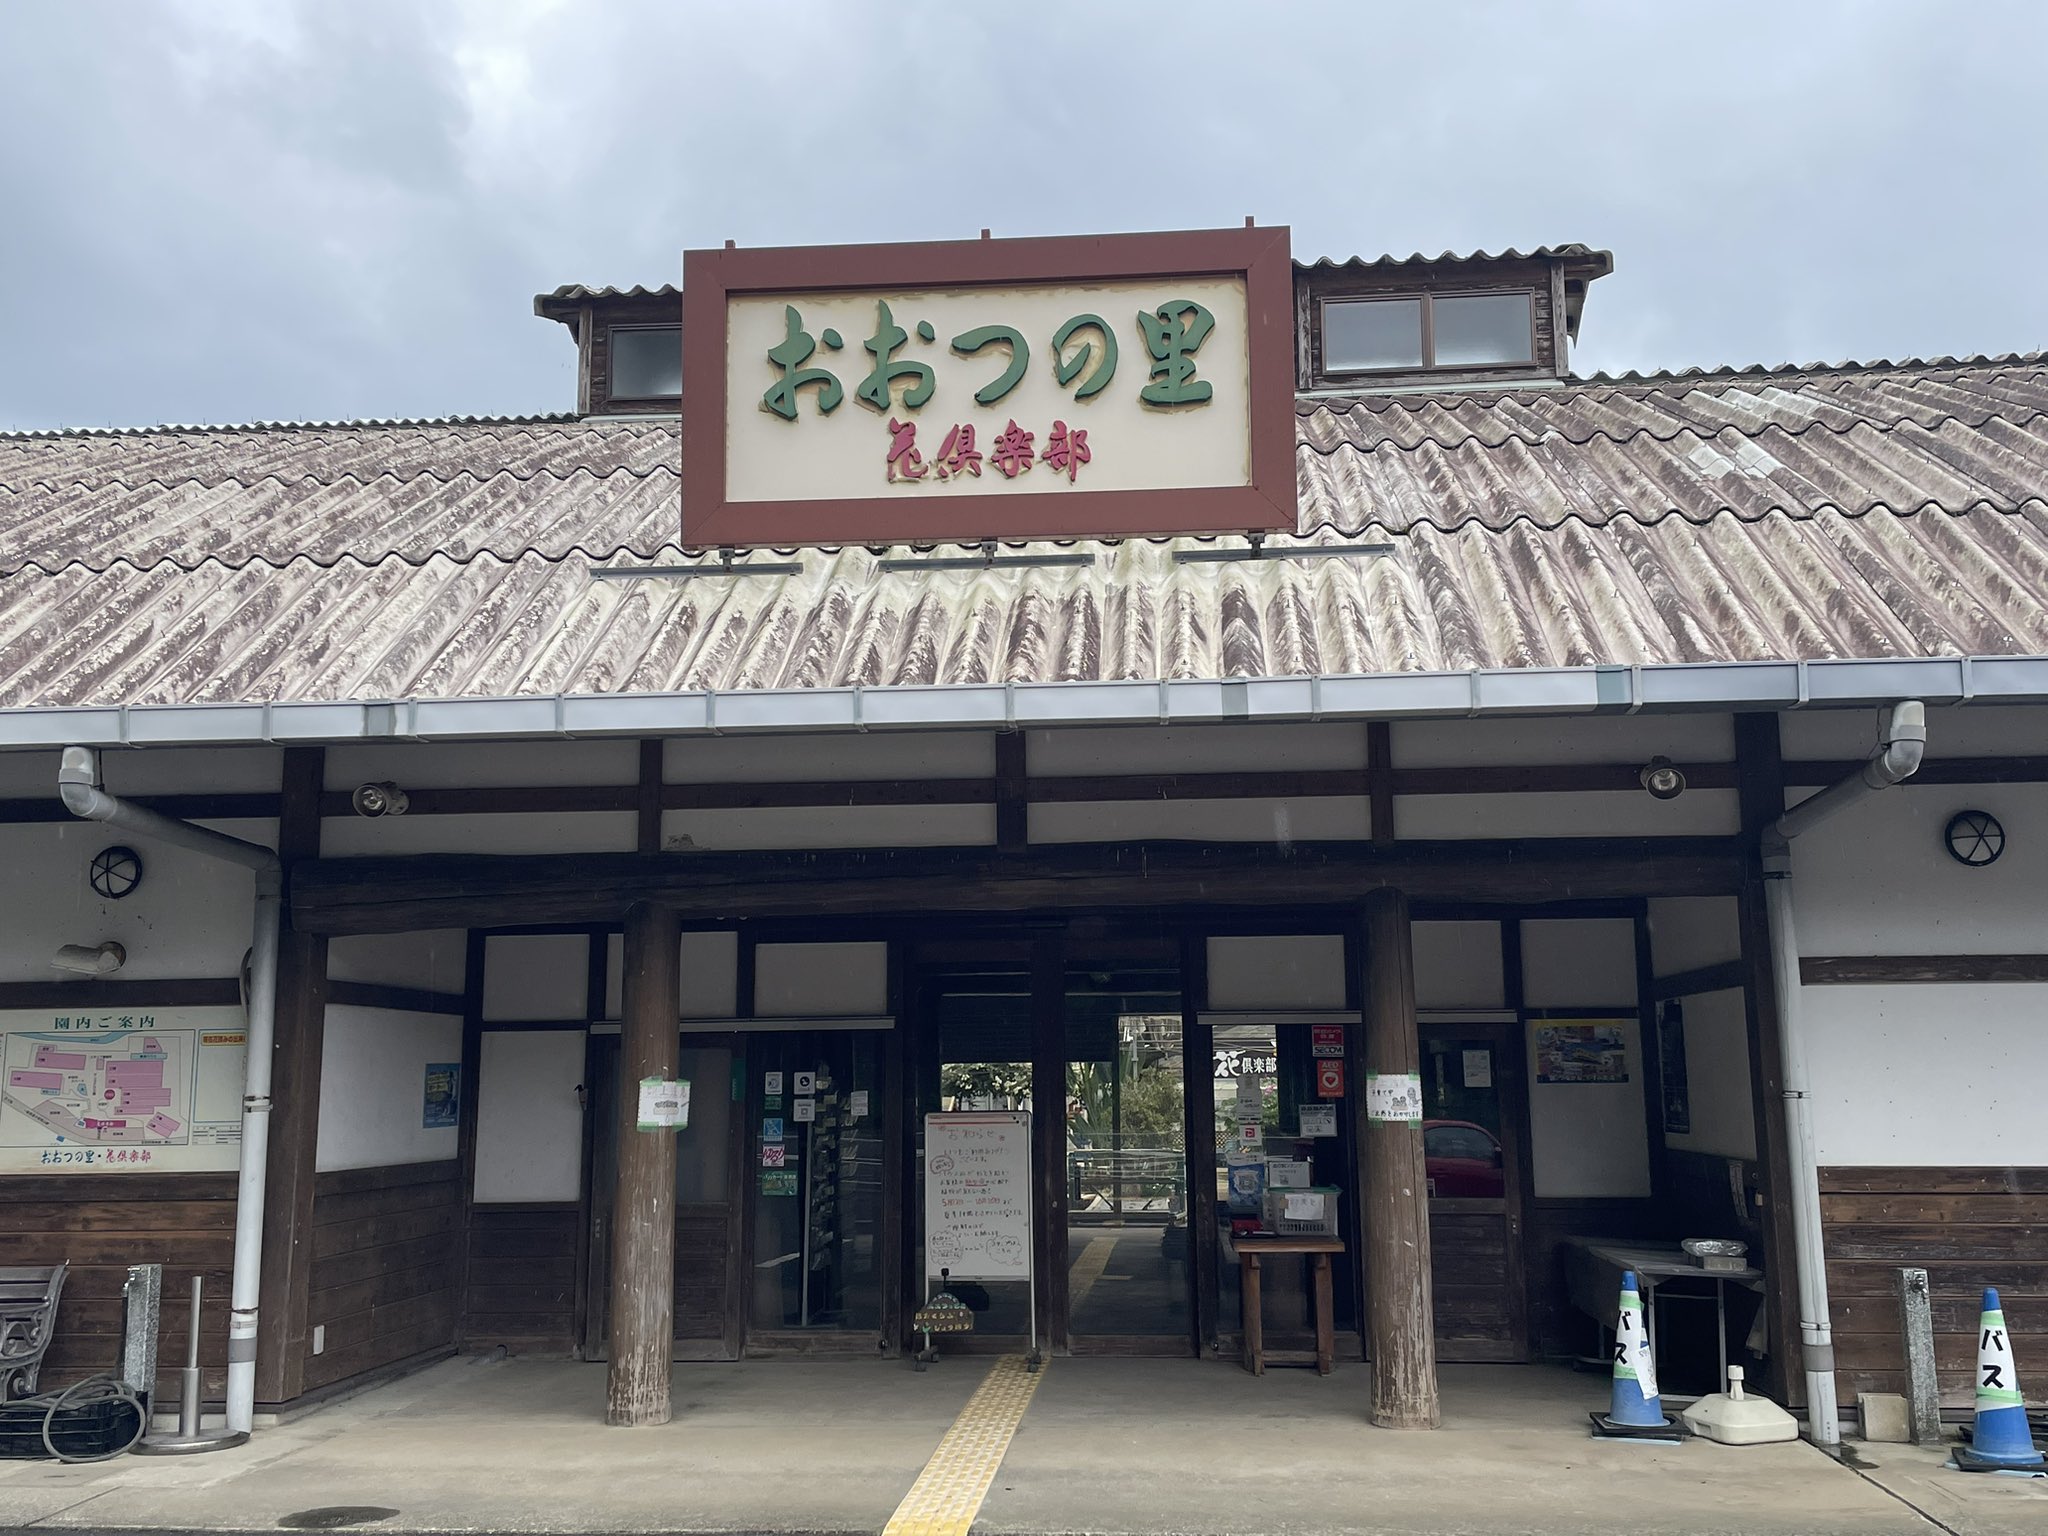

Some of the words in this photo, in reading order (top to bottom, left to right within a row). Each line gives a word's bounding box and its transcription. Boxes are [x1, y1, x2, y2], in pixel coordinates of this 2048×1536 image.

[763, 299, 1215, 422] おおつの里
[887, 417, 1091, 482] 花倶楽部
[54, 1015, 155, 1030] 園内ご案内
[1213, 1049, 1277, 1078] 花倶楽部
[1313, 1046, 1342, 1054] SECOM
[1322, 1061, 1339, 1069] AED
[947, 1127, 995, 1141] お知らせ
[1615, 1310, 1632, 1365] バス
[1981, 1329, 2004, 1389] バス
